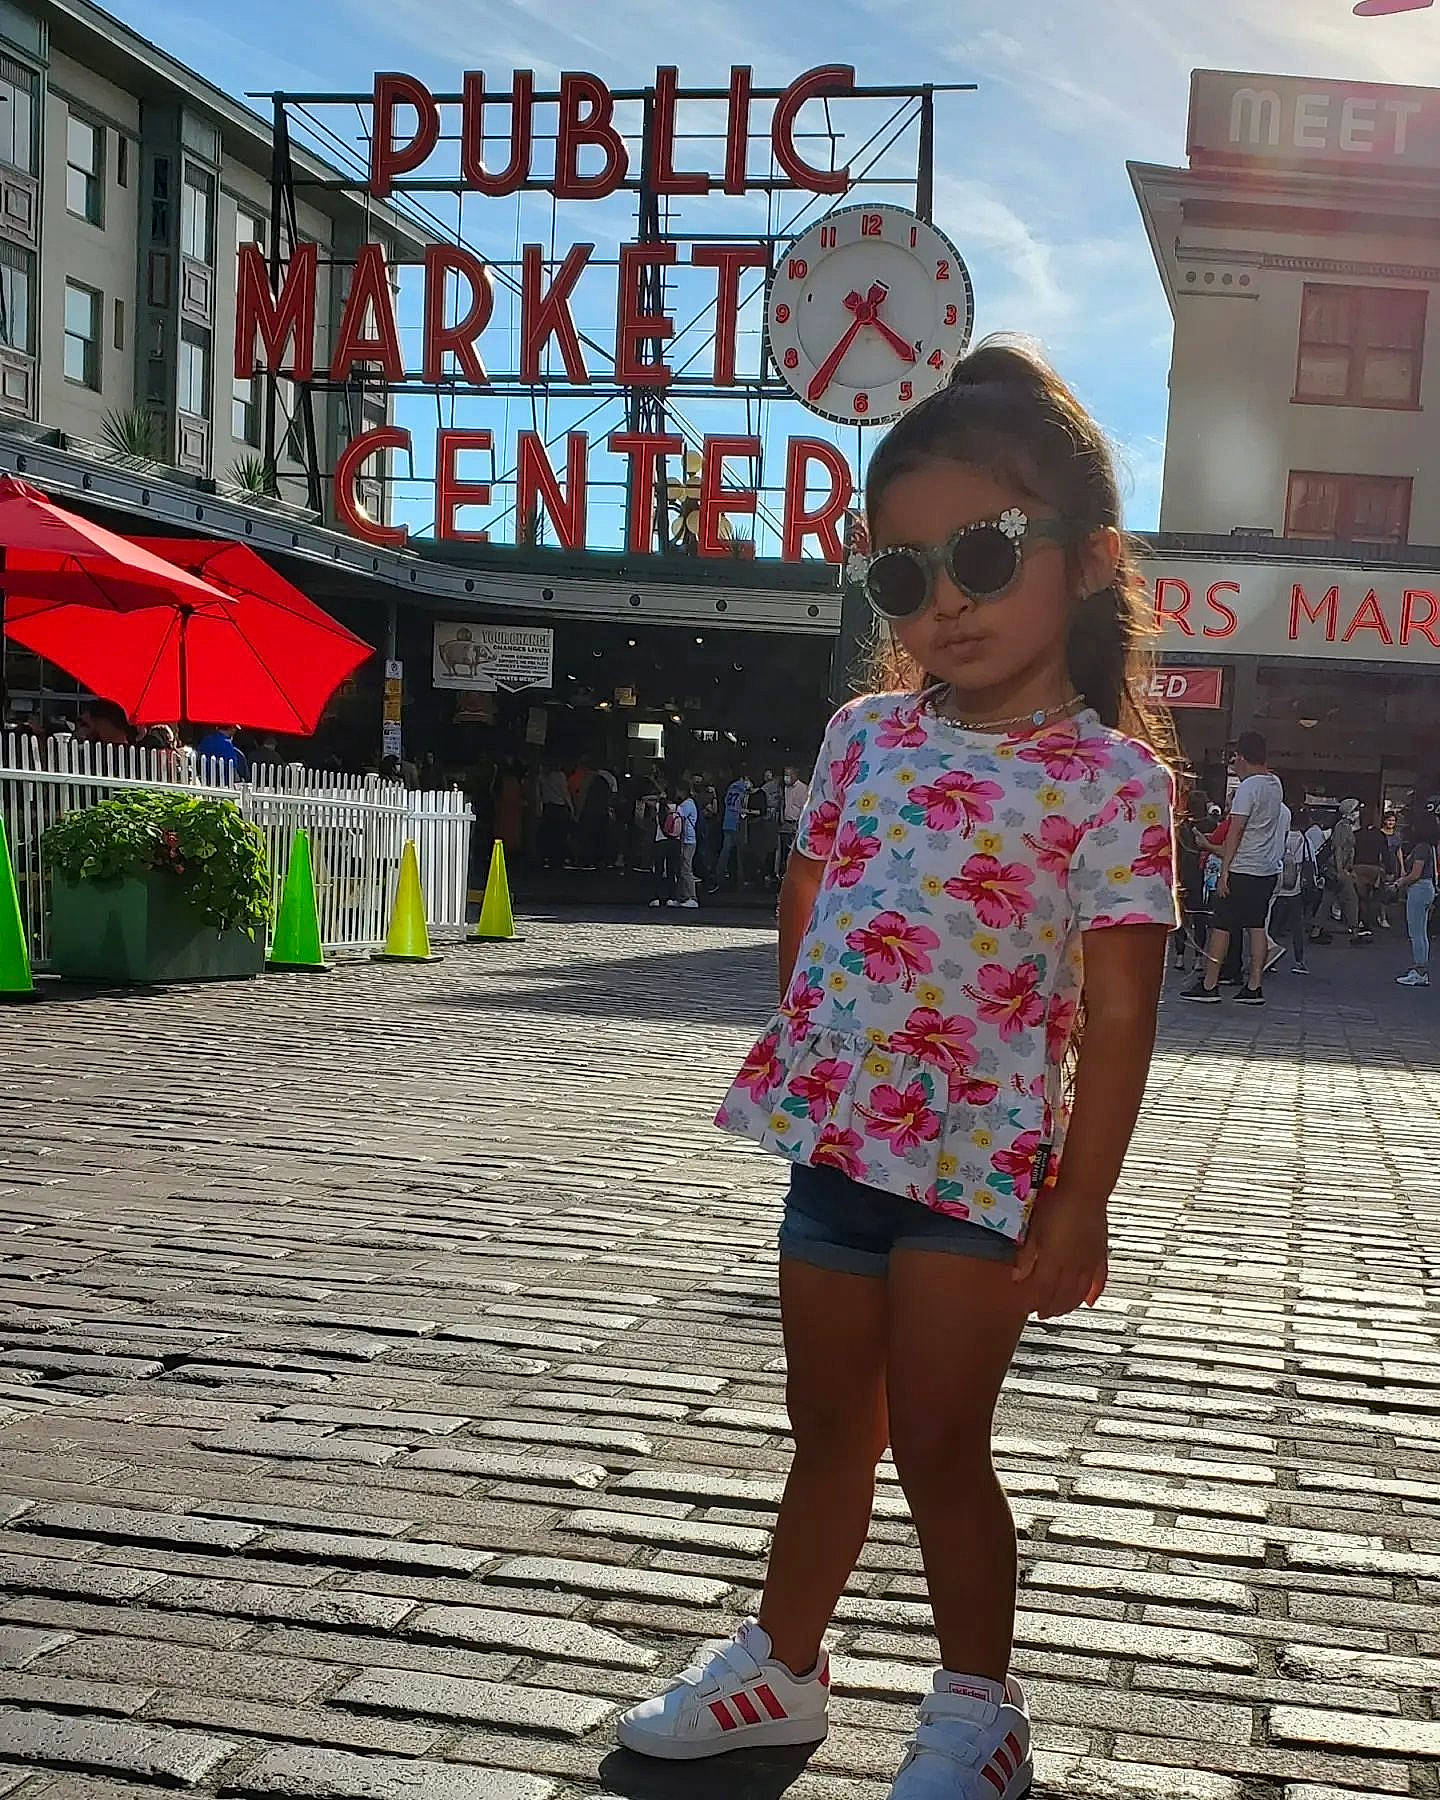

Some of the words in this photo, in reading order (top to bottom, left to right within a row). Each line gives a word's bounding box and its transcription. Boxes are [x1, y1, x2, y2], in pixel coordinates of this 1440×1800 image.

[371, 64, 855, 199] PUBLIC
[1229, 88, 1422, 155] MEET
[861, 214, 883, 236] 12
[820, 226, 837, 249] 11
[910, 226, 918, 249] 1
[788, 259, 808, 280] 10
[936, 260, 950, 281] 2
[234, 241, 772, 386] MARKET
[775, 303, 791, 324] 9
[944, 304, 958, 326] 3
[783, 347, 799, 369] 8
[927, 349, 944, 370] 4
[898, 381, 914, 401] 5
[853, 392, 869, 413] 6
[334, 426, 853, 564] CENTER
[1130, 575, 1241, 638] RS
[1289, 583, 1440, 648] MAR
